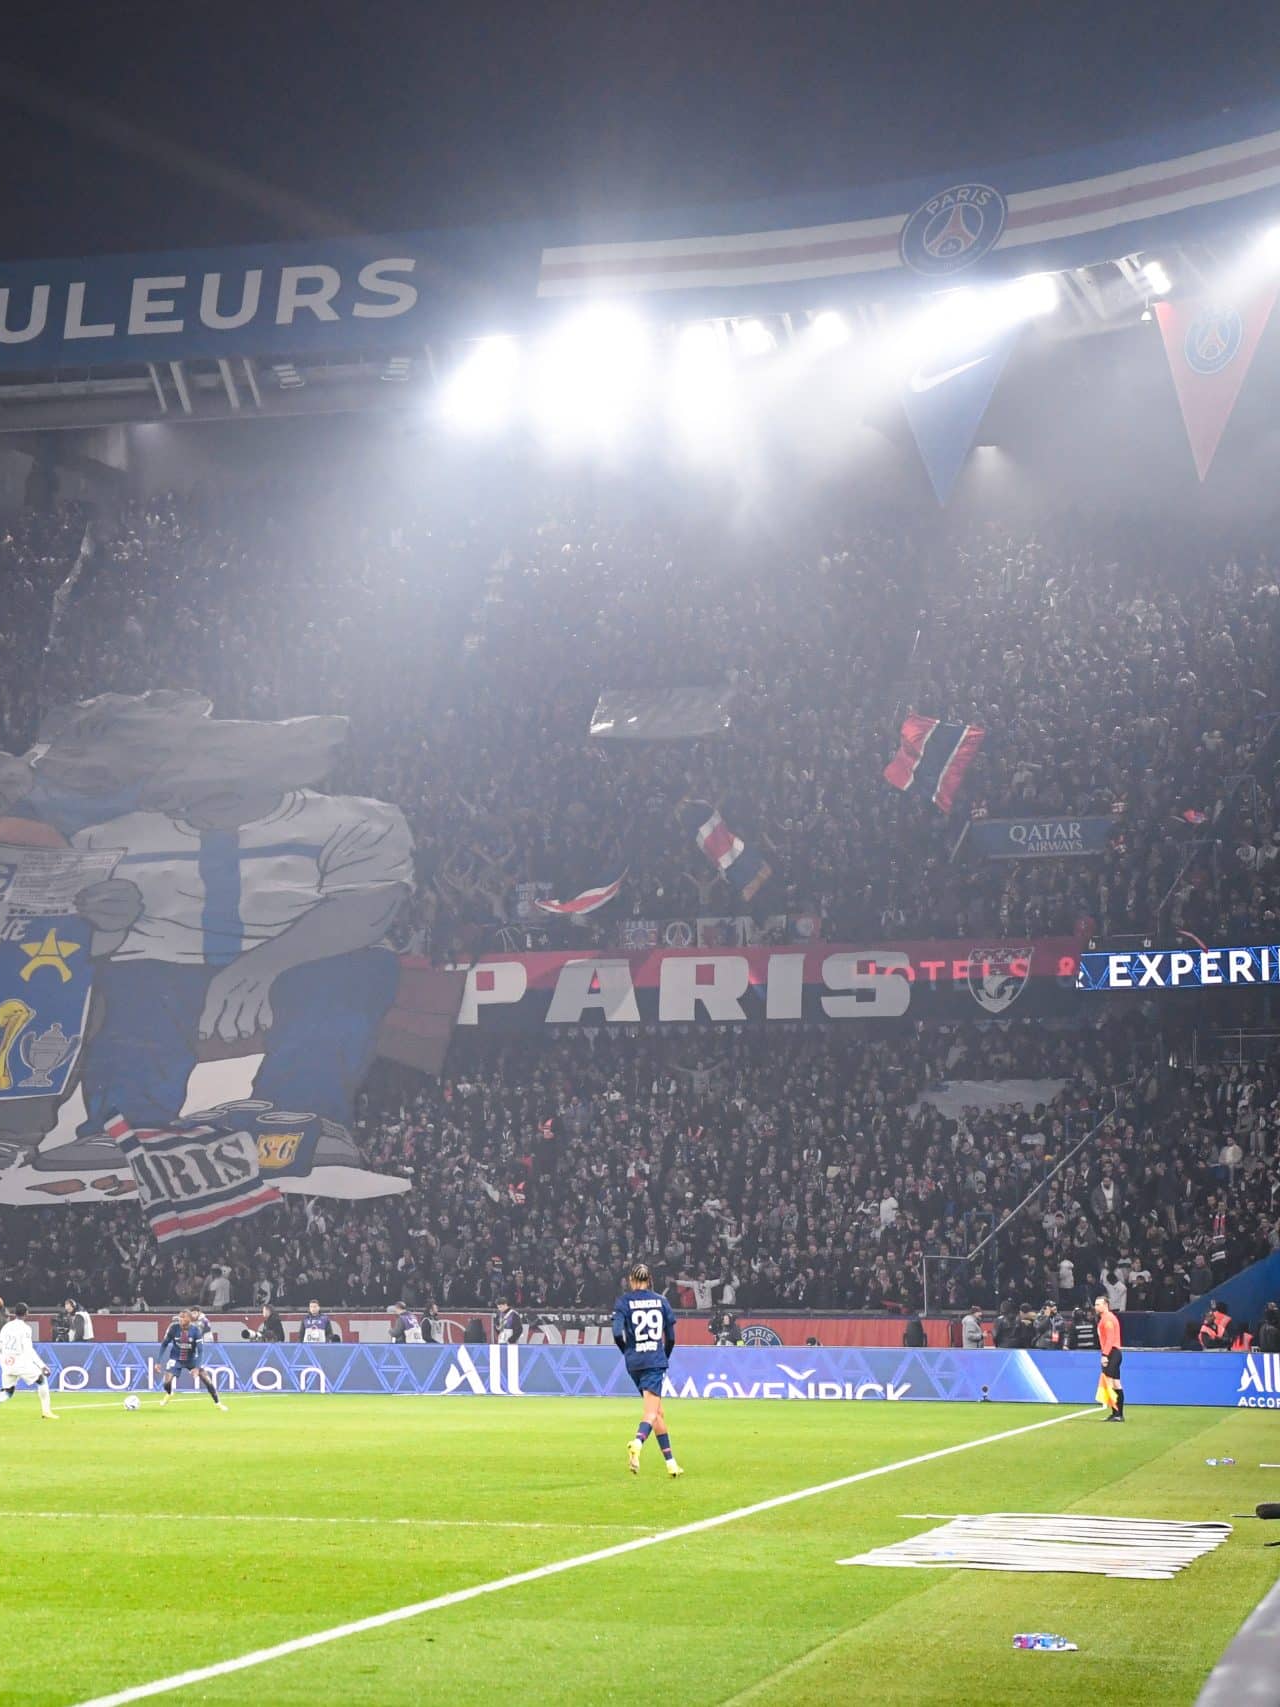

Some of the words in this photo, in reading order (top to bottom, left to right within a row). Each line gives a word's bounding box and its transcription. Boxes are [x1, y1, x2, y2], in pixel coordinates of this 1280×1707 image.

[926, 187, 993, 216] PARIS
[1009, 822, 1082, 845] QATAR
[1027, 839, 1083, 852] AIRWAYS
[455, 952, 911, 1025] PARIS
[631, 1309, 663, 1341] 29
[741, 1326, 774, 1342] PARIS
[4, 1335, 18, 1351] 22
[440, 1344, 524, 1394] All
[661, 1372, 912, 1400] MÖVENPICK
